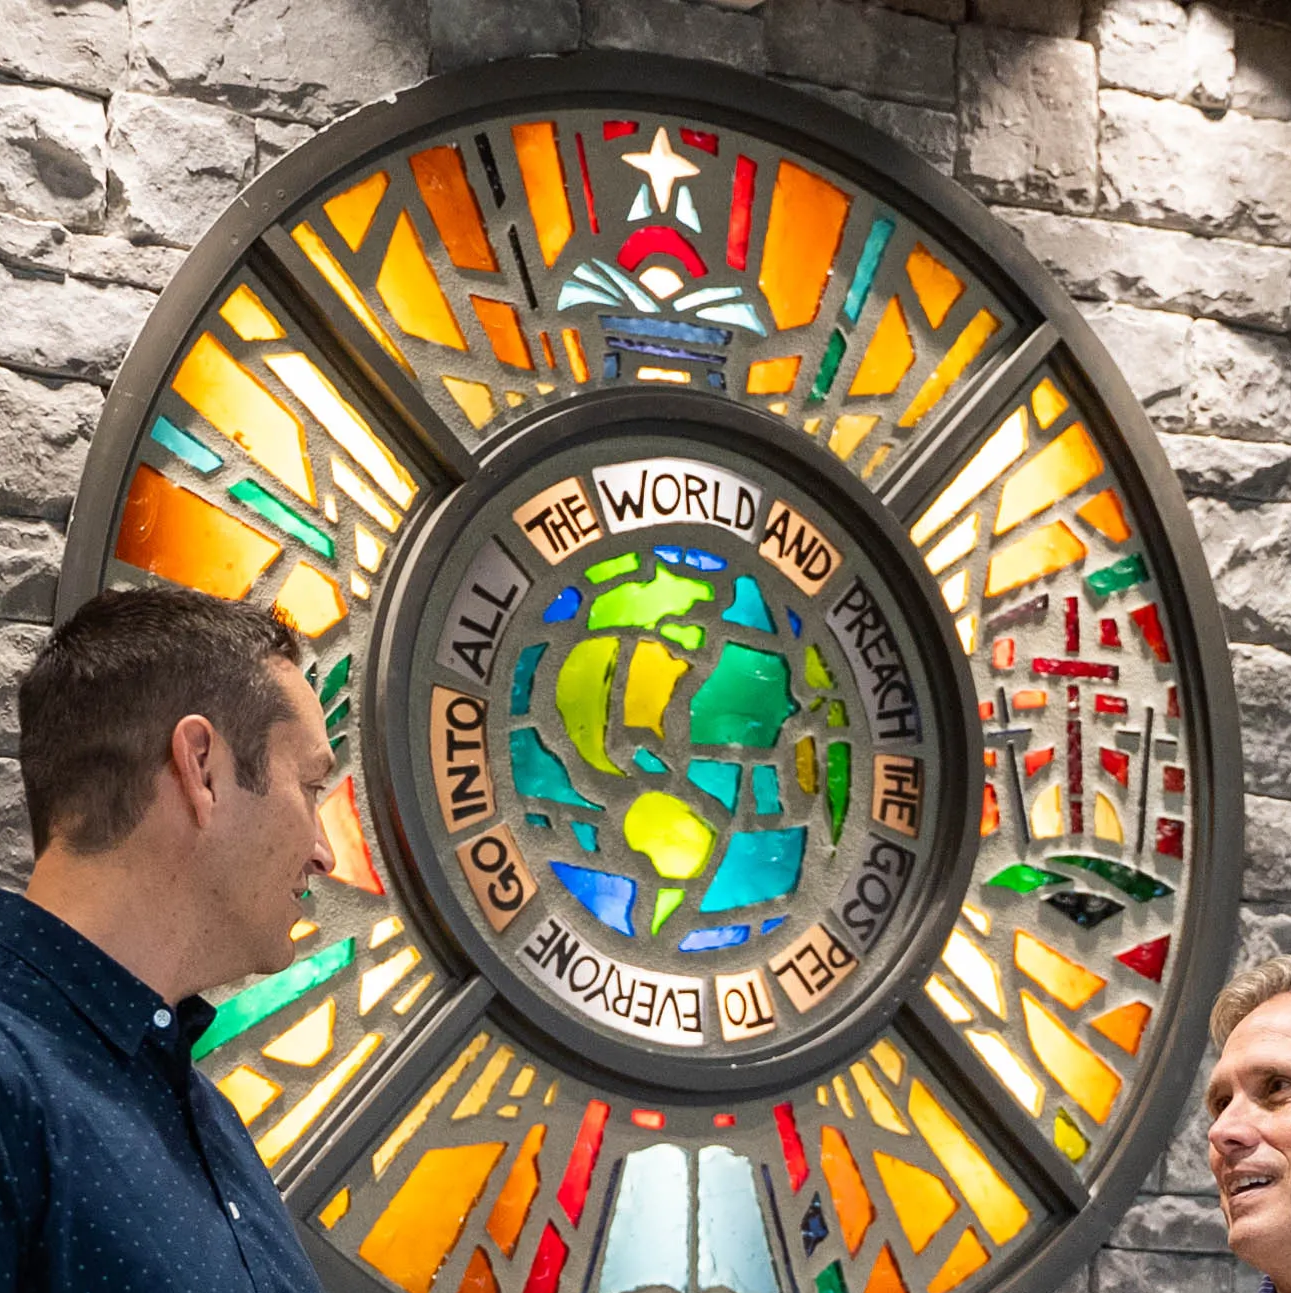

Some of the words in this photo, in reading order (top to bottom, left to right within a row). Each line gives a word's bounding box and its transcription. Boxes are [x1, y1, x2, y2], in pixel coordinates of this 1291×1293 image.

[525, 494, 600, 554] THE
[600, 470, 756, 531] WORLD
[764, 508, 832, 581] AND
[451, 581, 520, 680] ALL
[832, 582, 917, 740] PREACH
[446, 696, 487, 822] INTO
[882, 762, 918, 830] THE
[469, 835, 525, 912] GO
[525, 919, 703, 1033] EVERYONE
[724, 981, 774, 1029] TO
